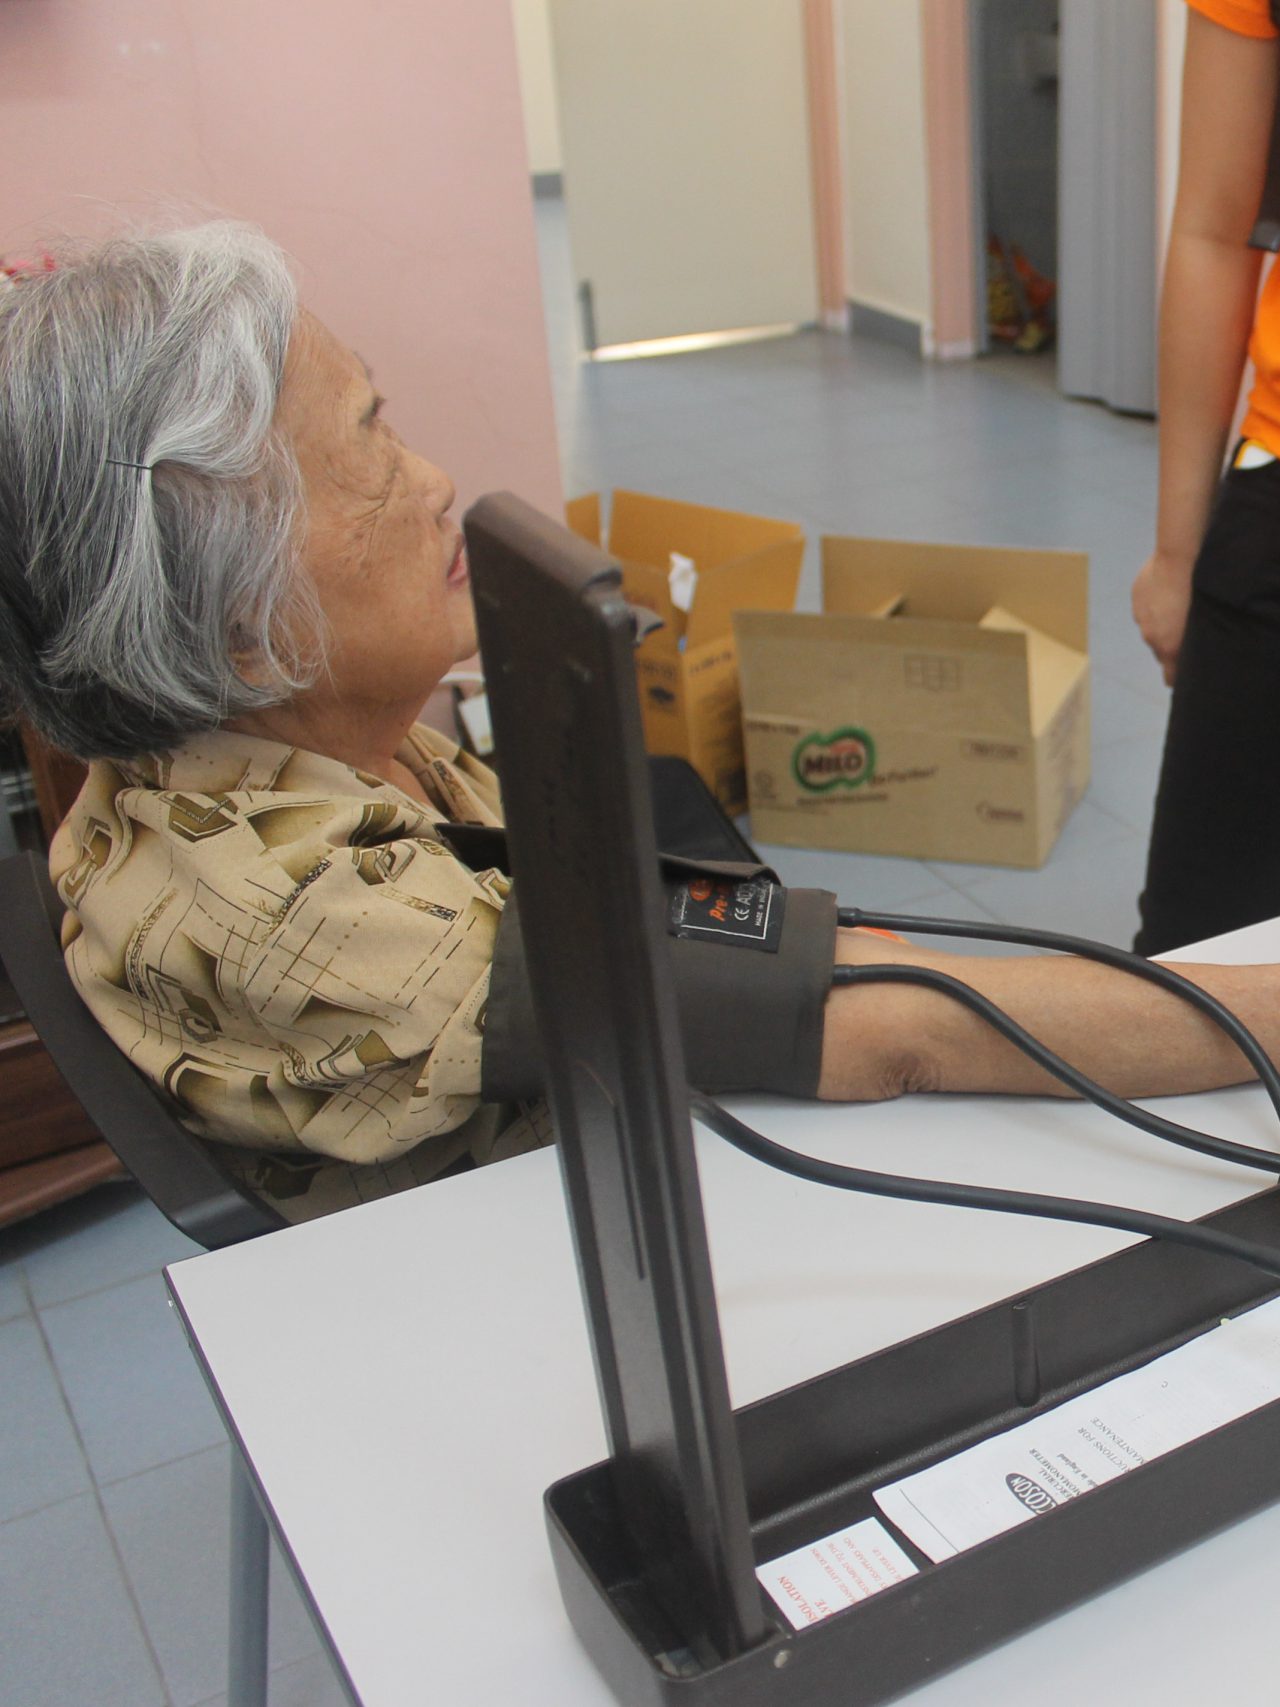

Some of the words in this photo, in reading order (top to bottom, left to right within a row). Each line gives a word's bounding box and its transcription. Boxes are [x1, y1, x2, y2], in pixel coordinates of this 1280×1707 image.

[803, 751, 863, 774] MILO
[1078, 1427, 1095, 1442] FOR
[1057, 1453, 1082, 1475] England
